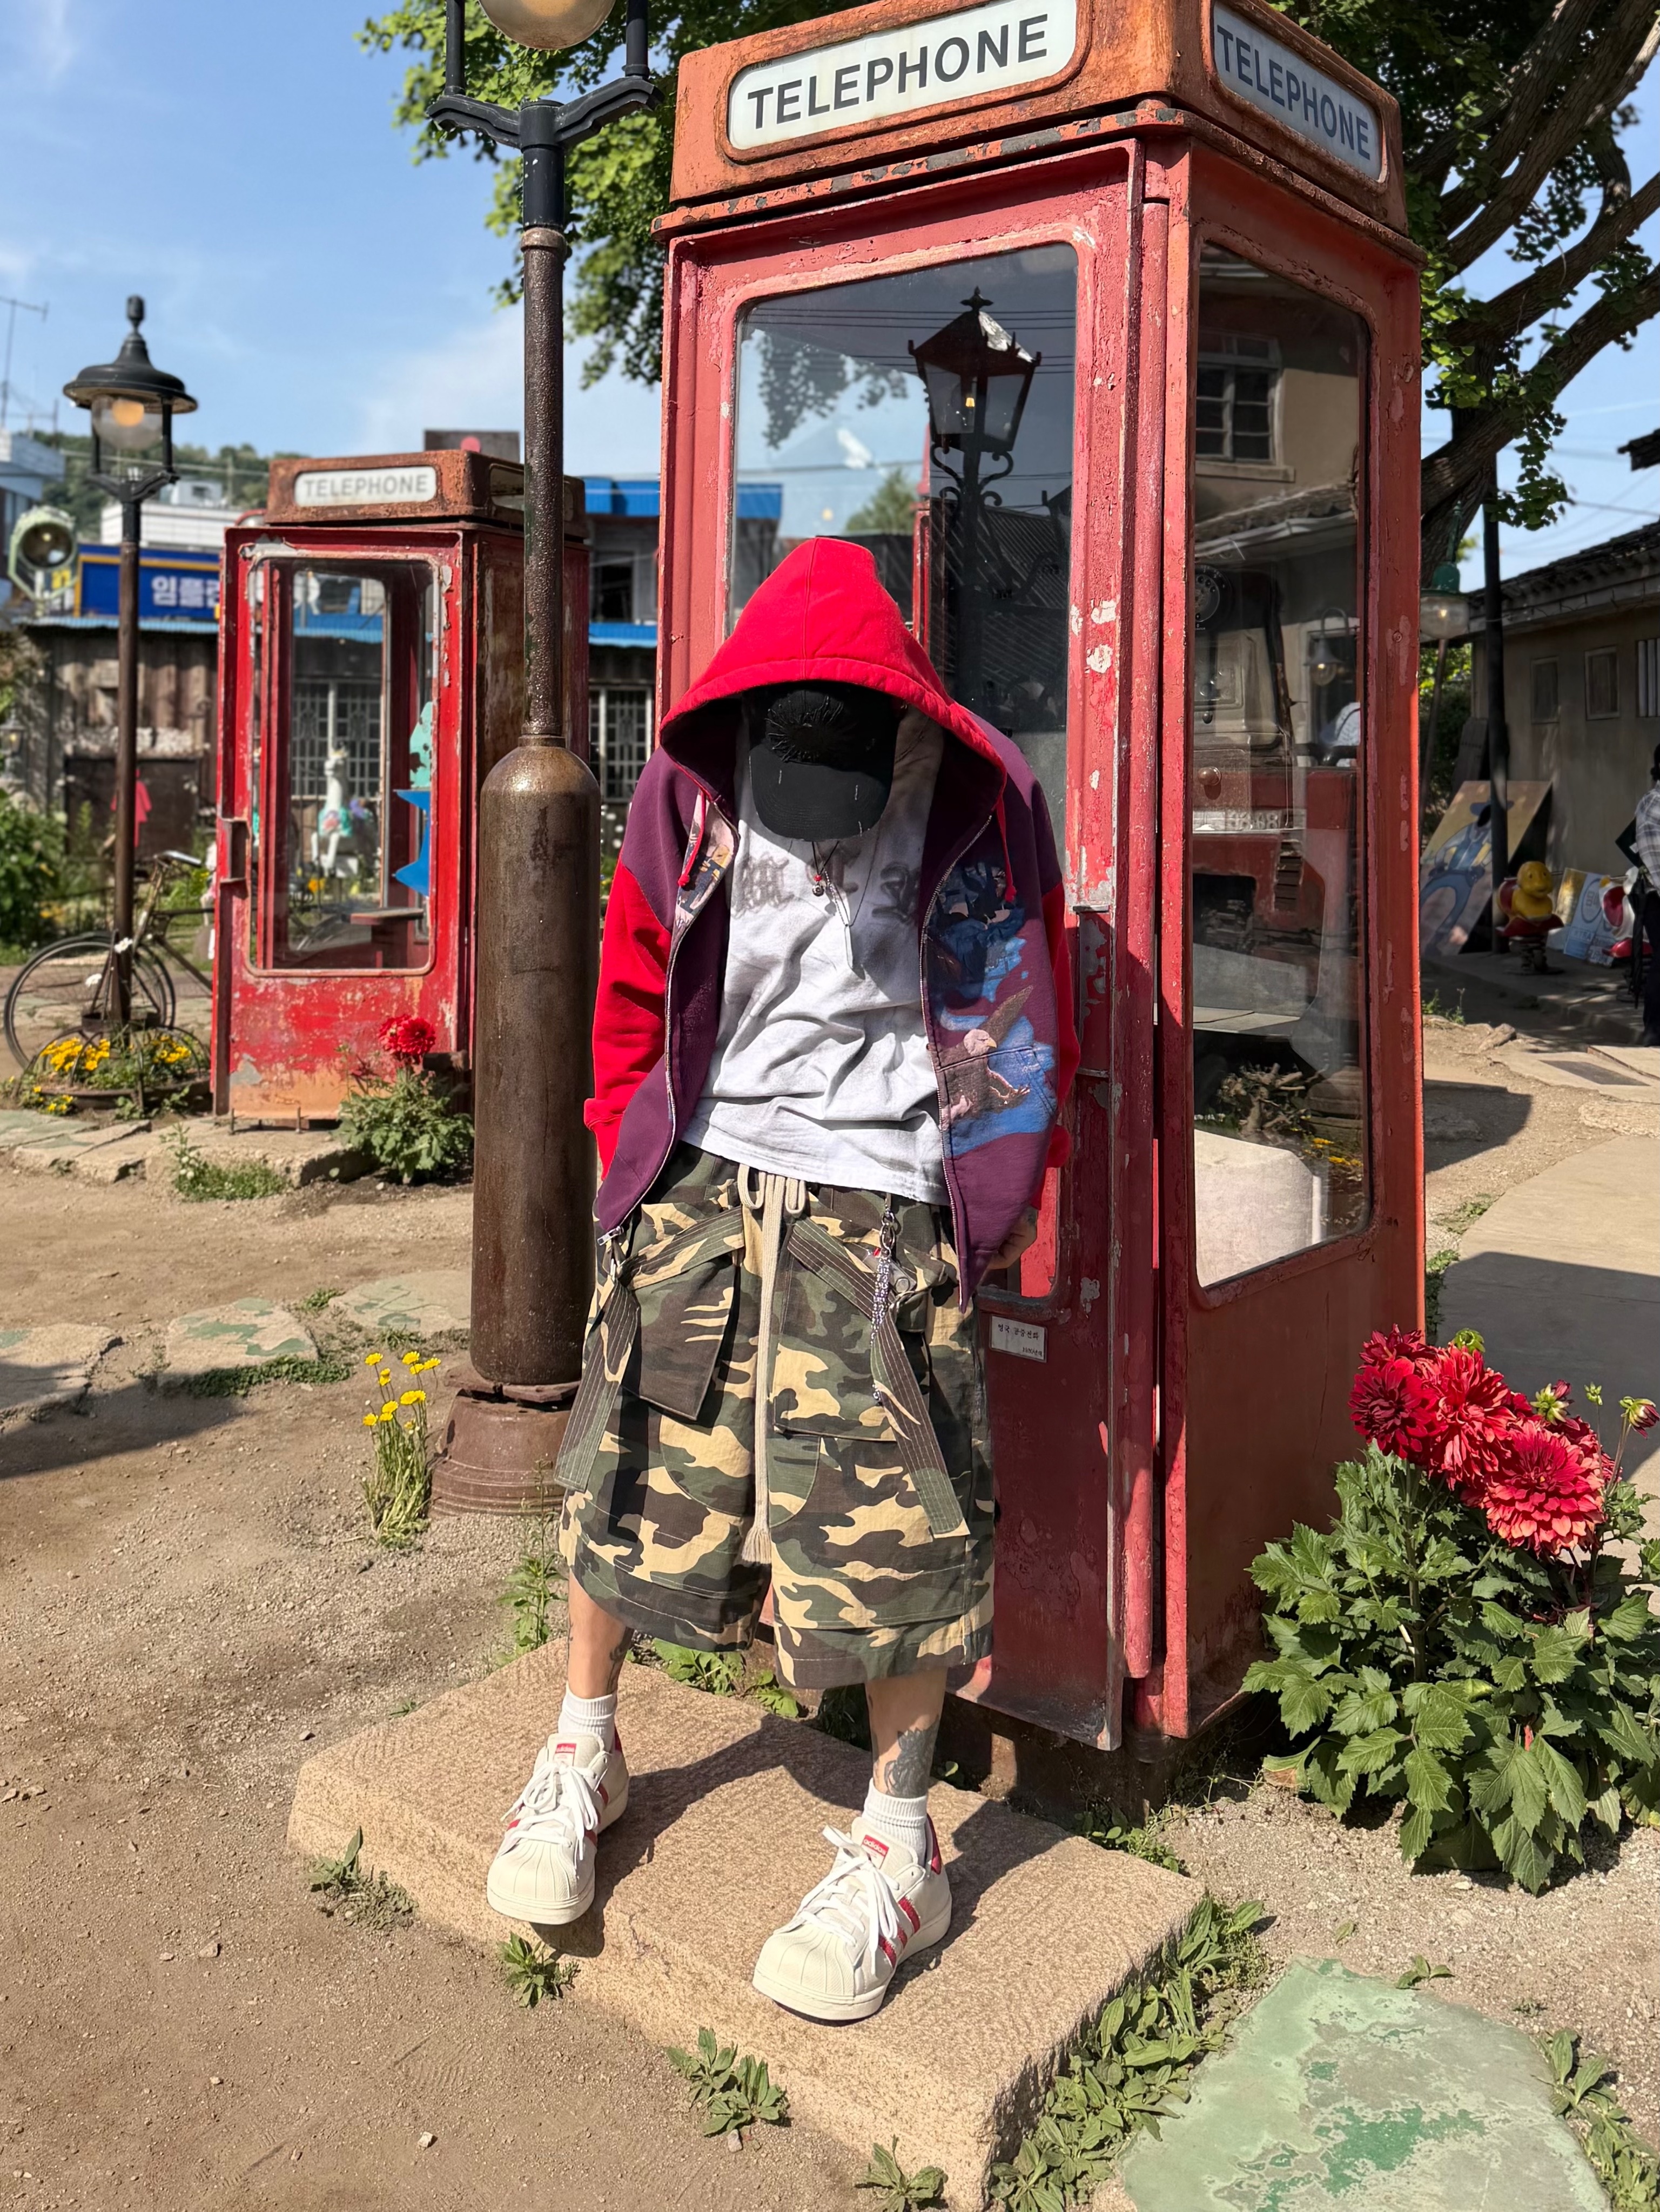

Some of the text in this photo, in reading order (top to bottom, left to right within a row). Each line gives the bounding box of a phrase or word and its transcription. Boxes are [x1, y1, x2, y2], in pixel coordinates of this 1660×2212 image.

[748, 14, 1048, 130] TELEPHONE
[1217, 25, 1370, 161] TELEPHONE
[304, 475, 428, 497] TELEPHONE
[998, 1324, 1010, 1333] 영국
[863, 1838, 886, 1856] adidas
